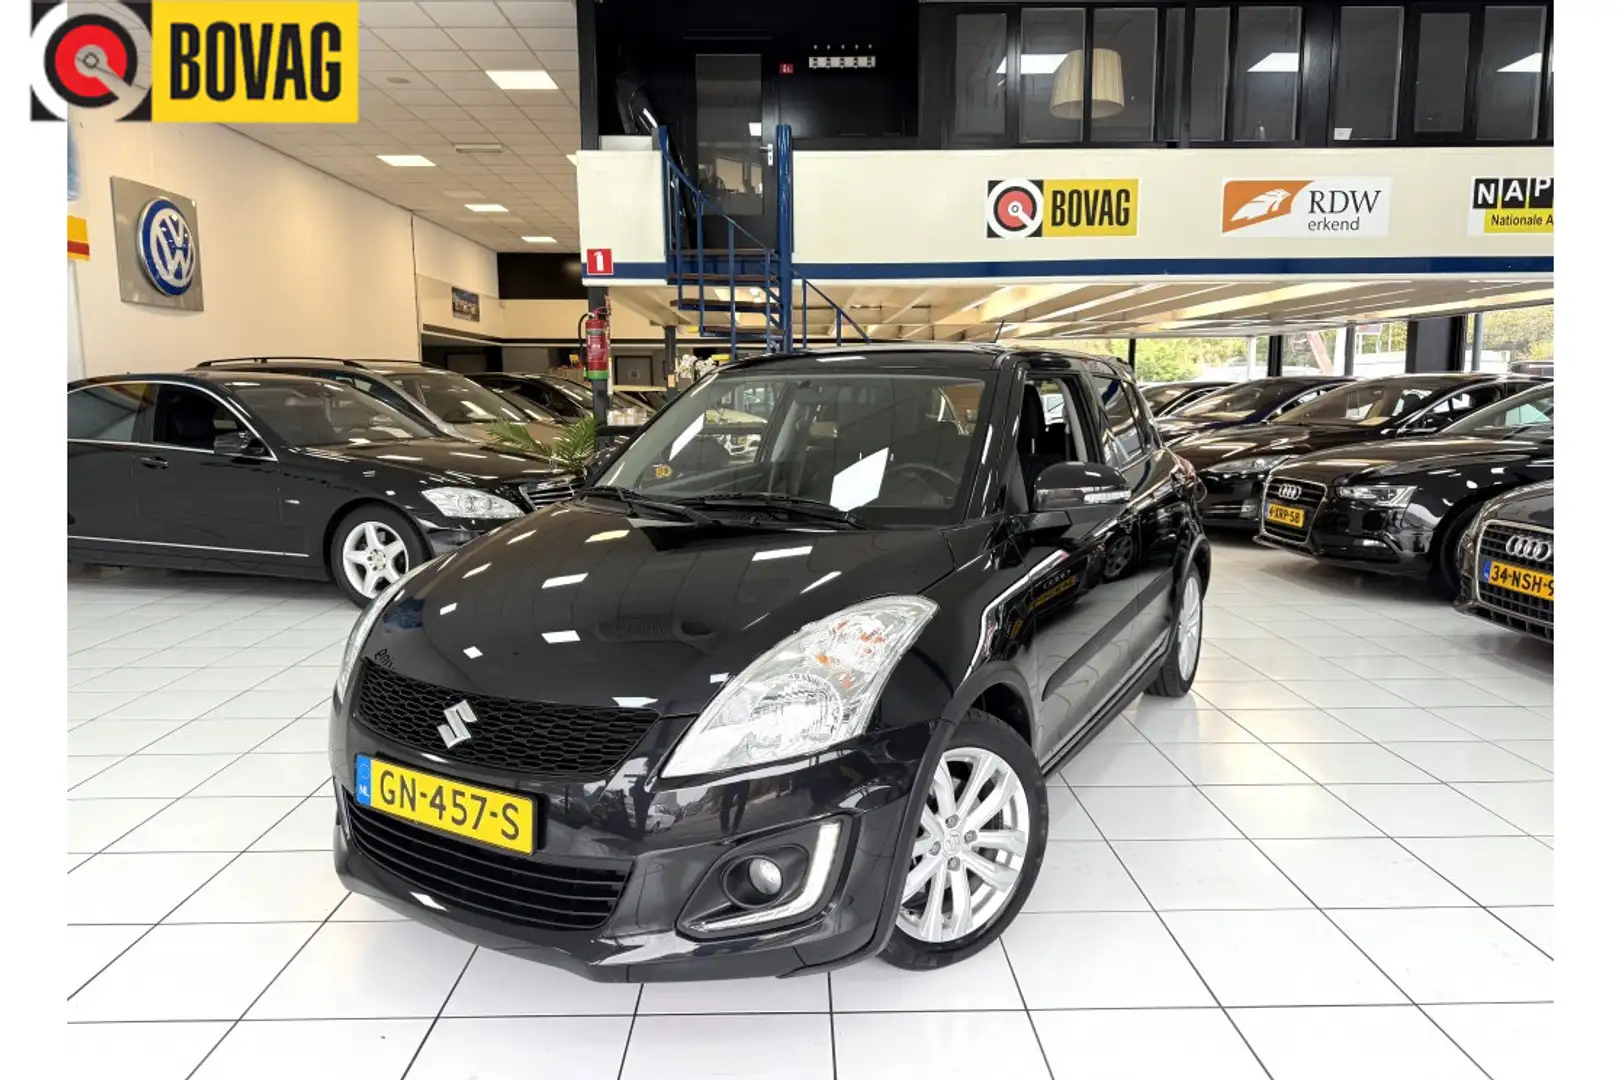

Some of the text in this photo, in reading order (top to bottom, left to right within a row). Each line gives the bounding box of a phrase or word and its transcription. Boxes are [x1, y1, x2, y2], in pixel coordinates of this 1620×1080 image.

[1308, 190, 1382, 214] RDW
[1477, 176, 1552, 204] NAP
[1051, 188, 1131, 227] BOVAG
[1491, 213, 1543, 226] Nationale
[1308, 217, 1360, 231] erkend
[593, 251, 604, 272] 1
[380, 770, 520, 841] GN-457-S
